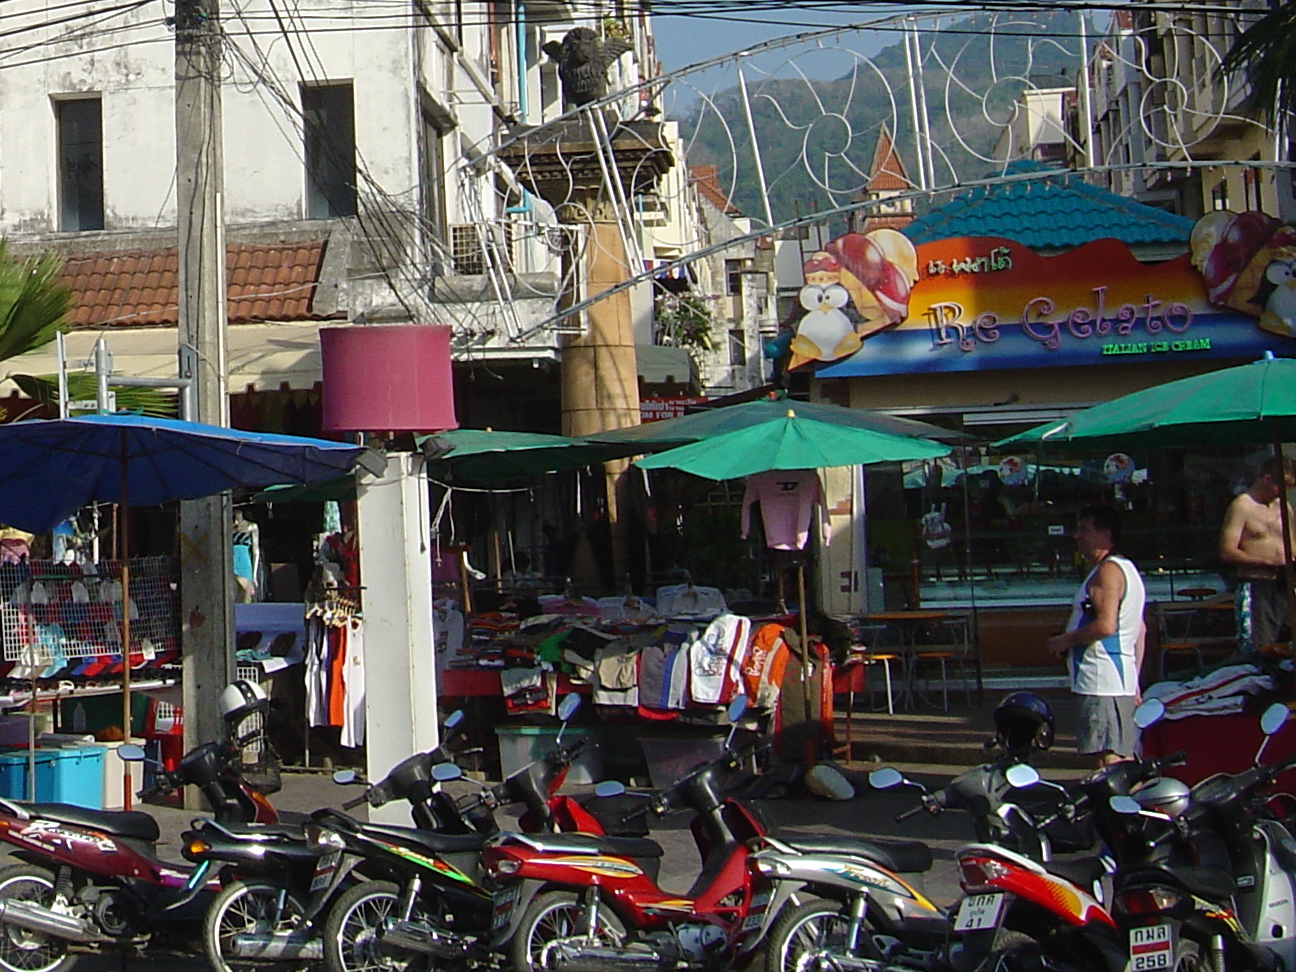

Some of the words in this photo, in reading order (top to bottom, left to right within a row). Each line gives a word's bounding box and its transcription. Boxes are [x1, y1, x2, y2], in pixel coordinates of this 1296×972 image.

[929, 300, 1001, 352] Re
[1021, 285, 1193, 351] Gelato
[1102, 342, 1148, 355] ITALIAN
[1150, 341, 1170, 352] ICE
[1171, 338, 1212, 351] CREAM
[965, 918, 983, 928] 41
[1135, 954, 1167, 970] 258
